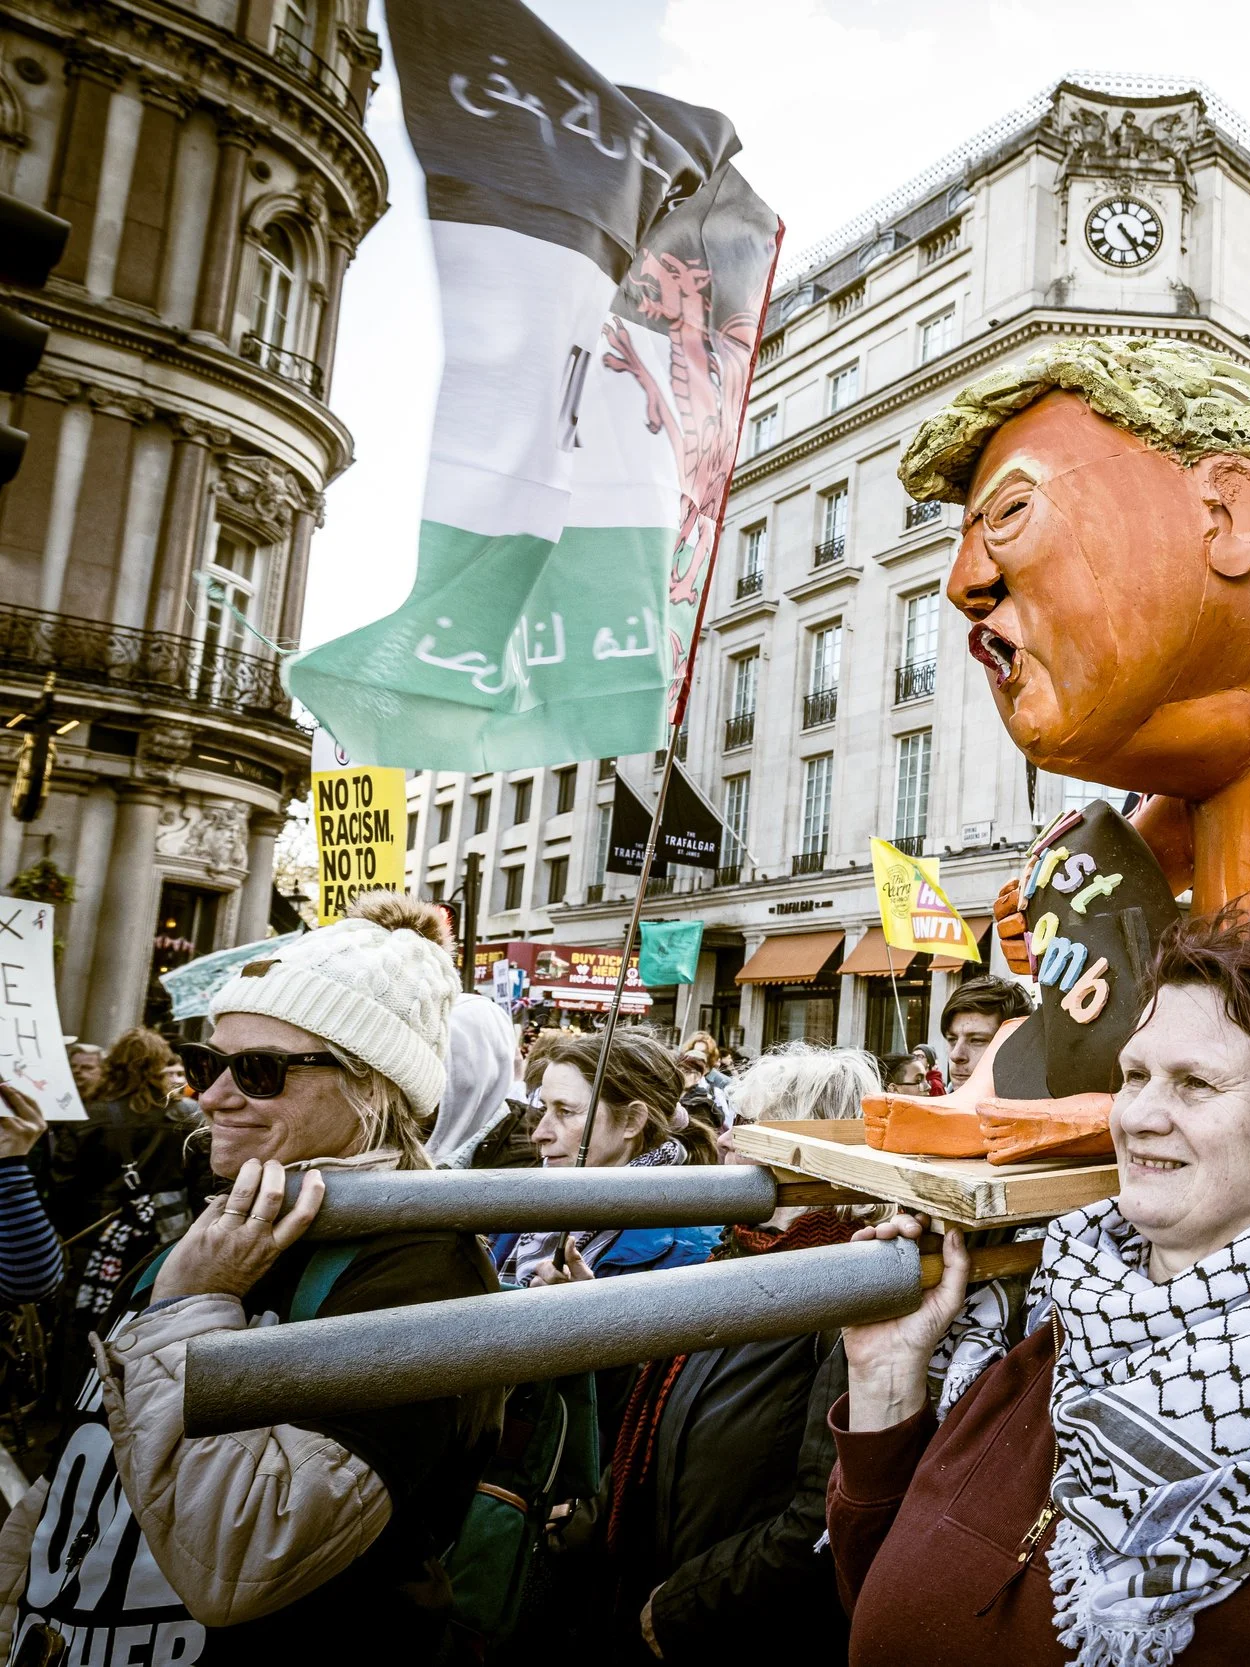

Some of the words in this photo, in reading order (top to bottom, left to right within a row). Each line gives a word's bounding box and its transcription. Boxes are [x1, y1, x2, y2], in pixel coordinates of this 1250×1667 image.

[318, 778, 349, 812] NO
[353, 775, 373, 809] TO
[320, 809, 394, 847] RACISM,
[665, 834, 715, 852] TRAFALGAR
[323, 849, 351, 882] NO
[355, 847, 376, 881] TO
[571, 952, 596, 965] BUY
